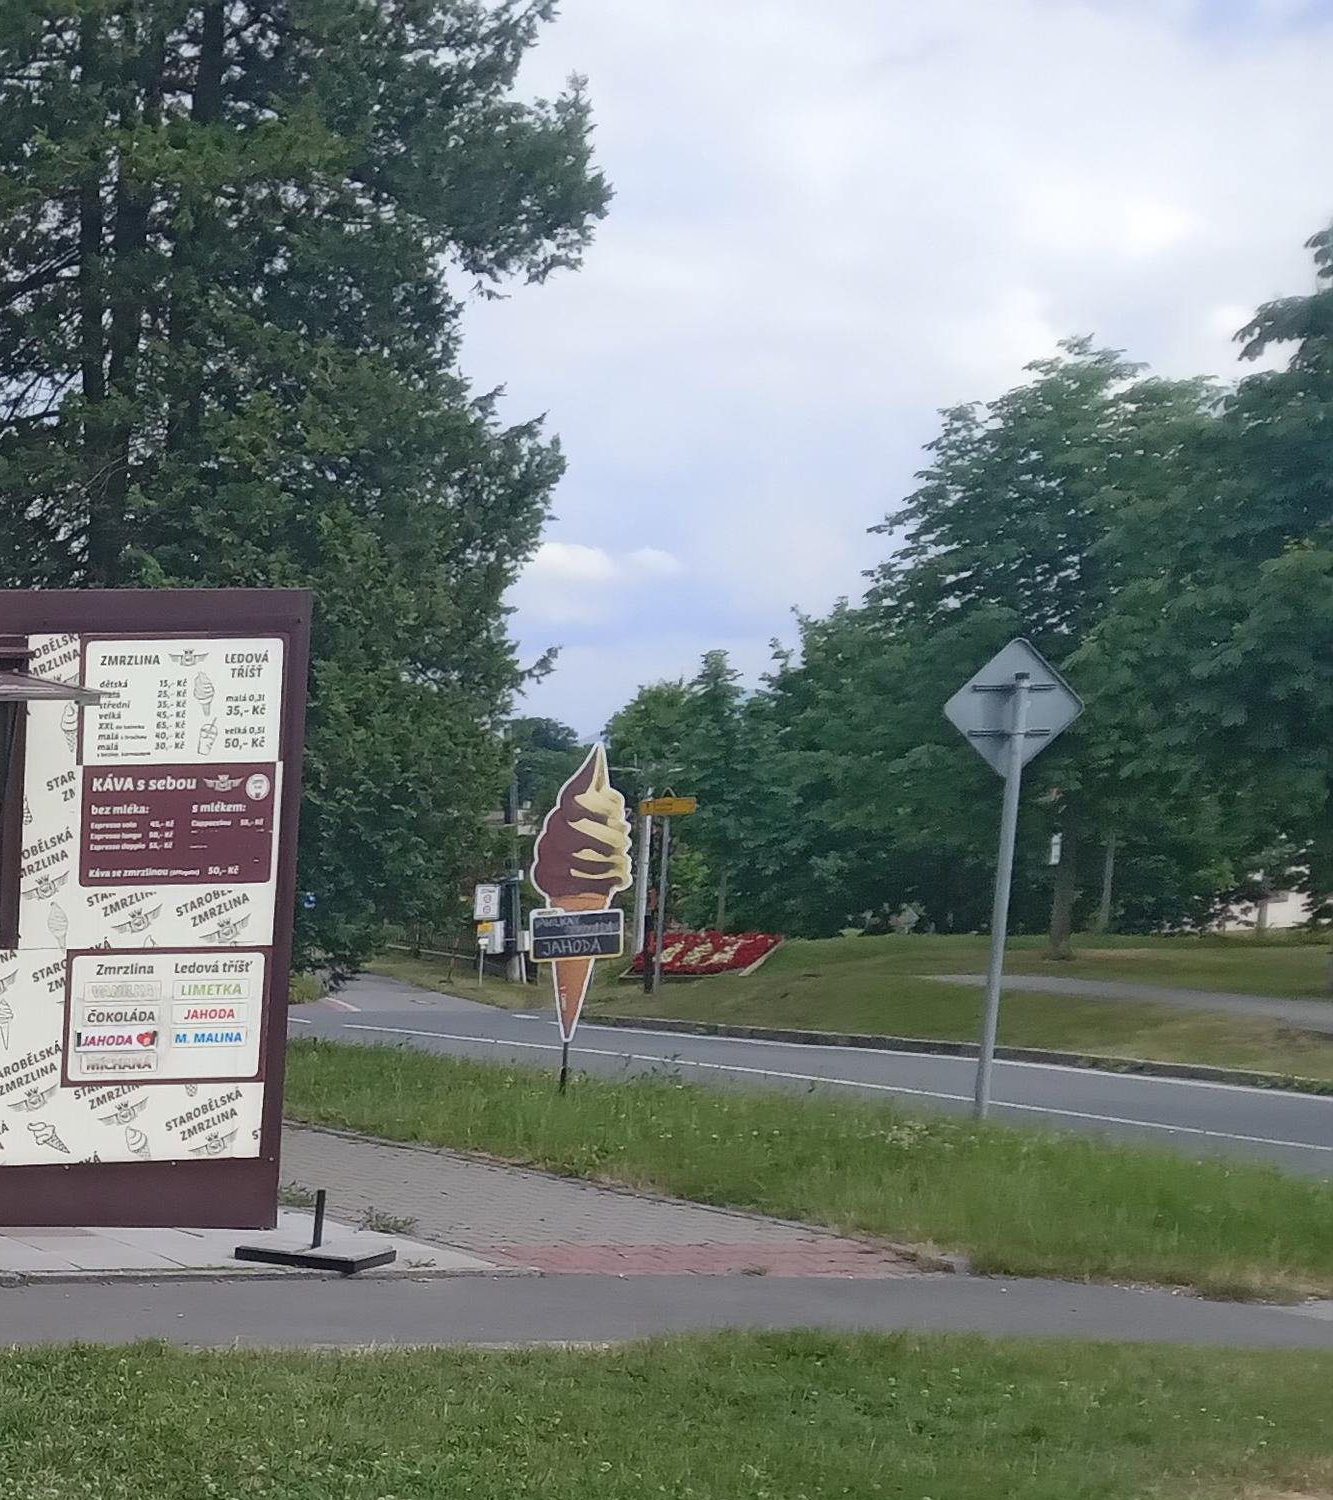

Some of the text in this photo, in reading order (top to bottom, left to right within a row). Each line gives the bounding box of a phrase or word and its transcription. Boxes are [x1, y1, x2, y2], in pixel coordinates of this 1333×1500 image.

[100, 655, 161, 666] ZMRZLINA
[225, 650, 269, 664] LEDOVÁ
[230, 664, 263, 678] TŘÍŠŤ
[99, 678, 188, 688] dětská 15,- Kč
[176, 689, 187, 697] Kč
[226, 693, 247, 702] malá
[99, 700, 130, 709] střední
[176, 699, 187, 708] Kč
[226, 704, 266, 717] 35,- Kč
[99, 711, 121, 720] velká
[175, 710, 187, 718] Kč
[98, 722, 114, 730] XXL
[175, 720, 186, 729] Kč
[225, 726, 247, 734] velká
[98, 732, 119, 740] malá
[155, 732, 172, 740] 40,-
[174, 731, 186, 739] Kč
[97, 743, 119, 751] malá
[174, 741, 185, 750] Kč
[224, 736, 265, 750] 50,- Kč
[92, 773, 197, 792] KÁVA s sebou
[91, 802, 150, 815] bez mléka:
[191, 801, 247, 813] s mlékem:
[88, 868, 111, 878] Káva
[111, 869, 122, 878] se
[123, 867, 169, 877] zmrzlinou
[208, 866, 227, 876] 50,-
[228, 865, 239, 875] Kč
[190, 892, 250, 927] ZMRZLINA
[542, 938, 602, 956] JAHODA
[96, 963, 154, 976] Zmrzlina
[174, 960, 253, 974] Ledová tříšť
[181, 983, 242, 996] LIMETKA
[87, 1008, 155, 1023] ČOKOLÁDA
[184, 1008, 235, 1020] JAHODA
[82, 1034, 133, 1047] JAHODA
[175, 1032, 242, 1044] M. MALINA
[165, 1085, 244, 1132] STAROBĚLSKÁ
[180, 1107, 238, 1142] ZMRZLINA
